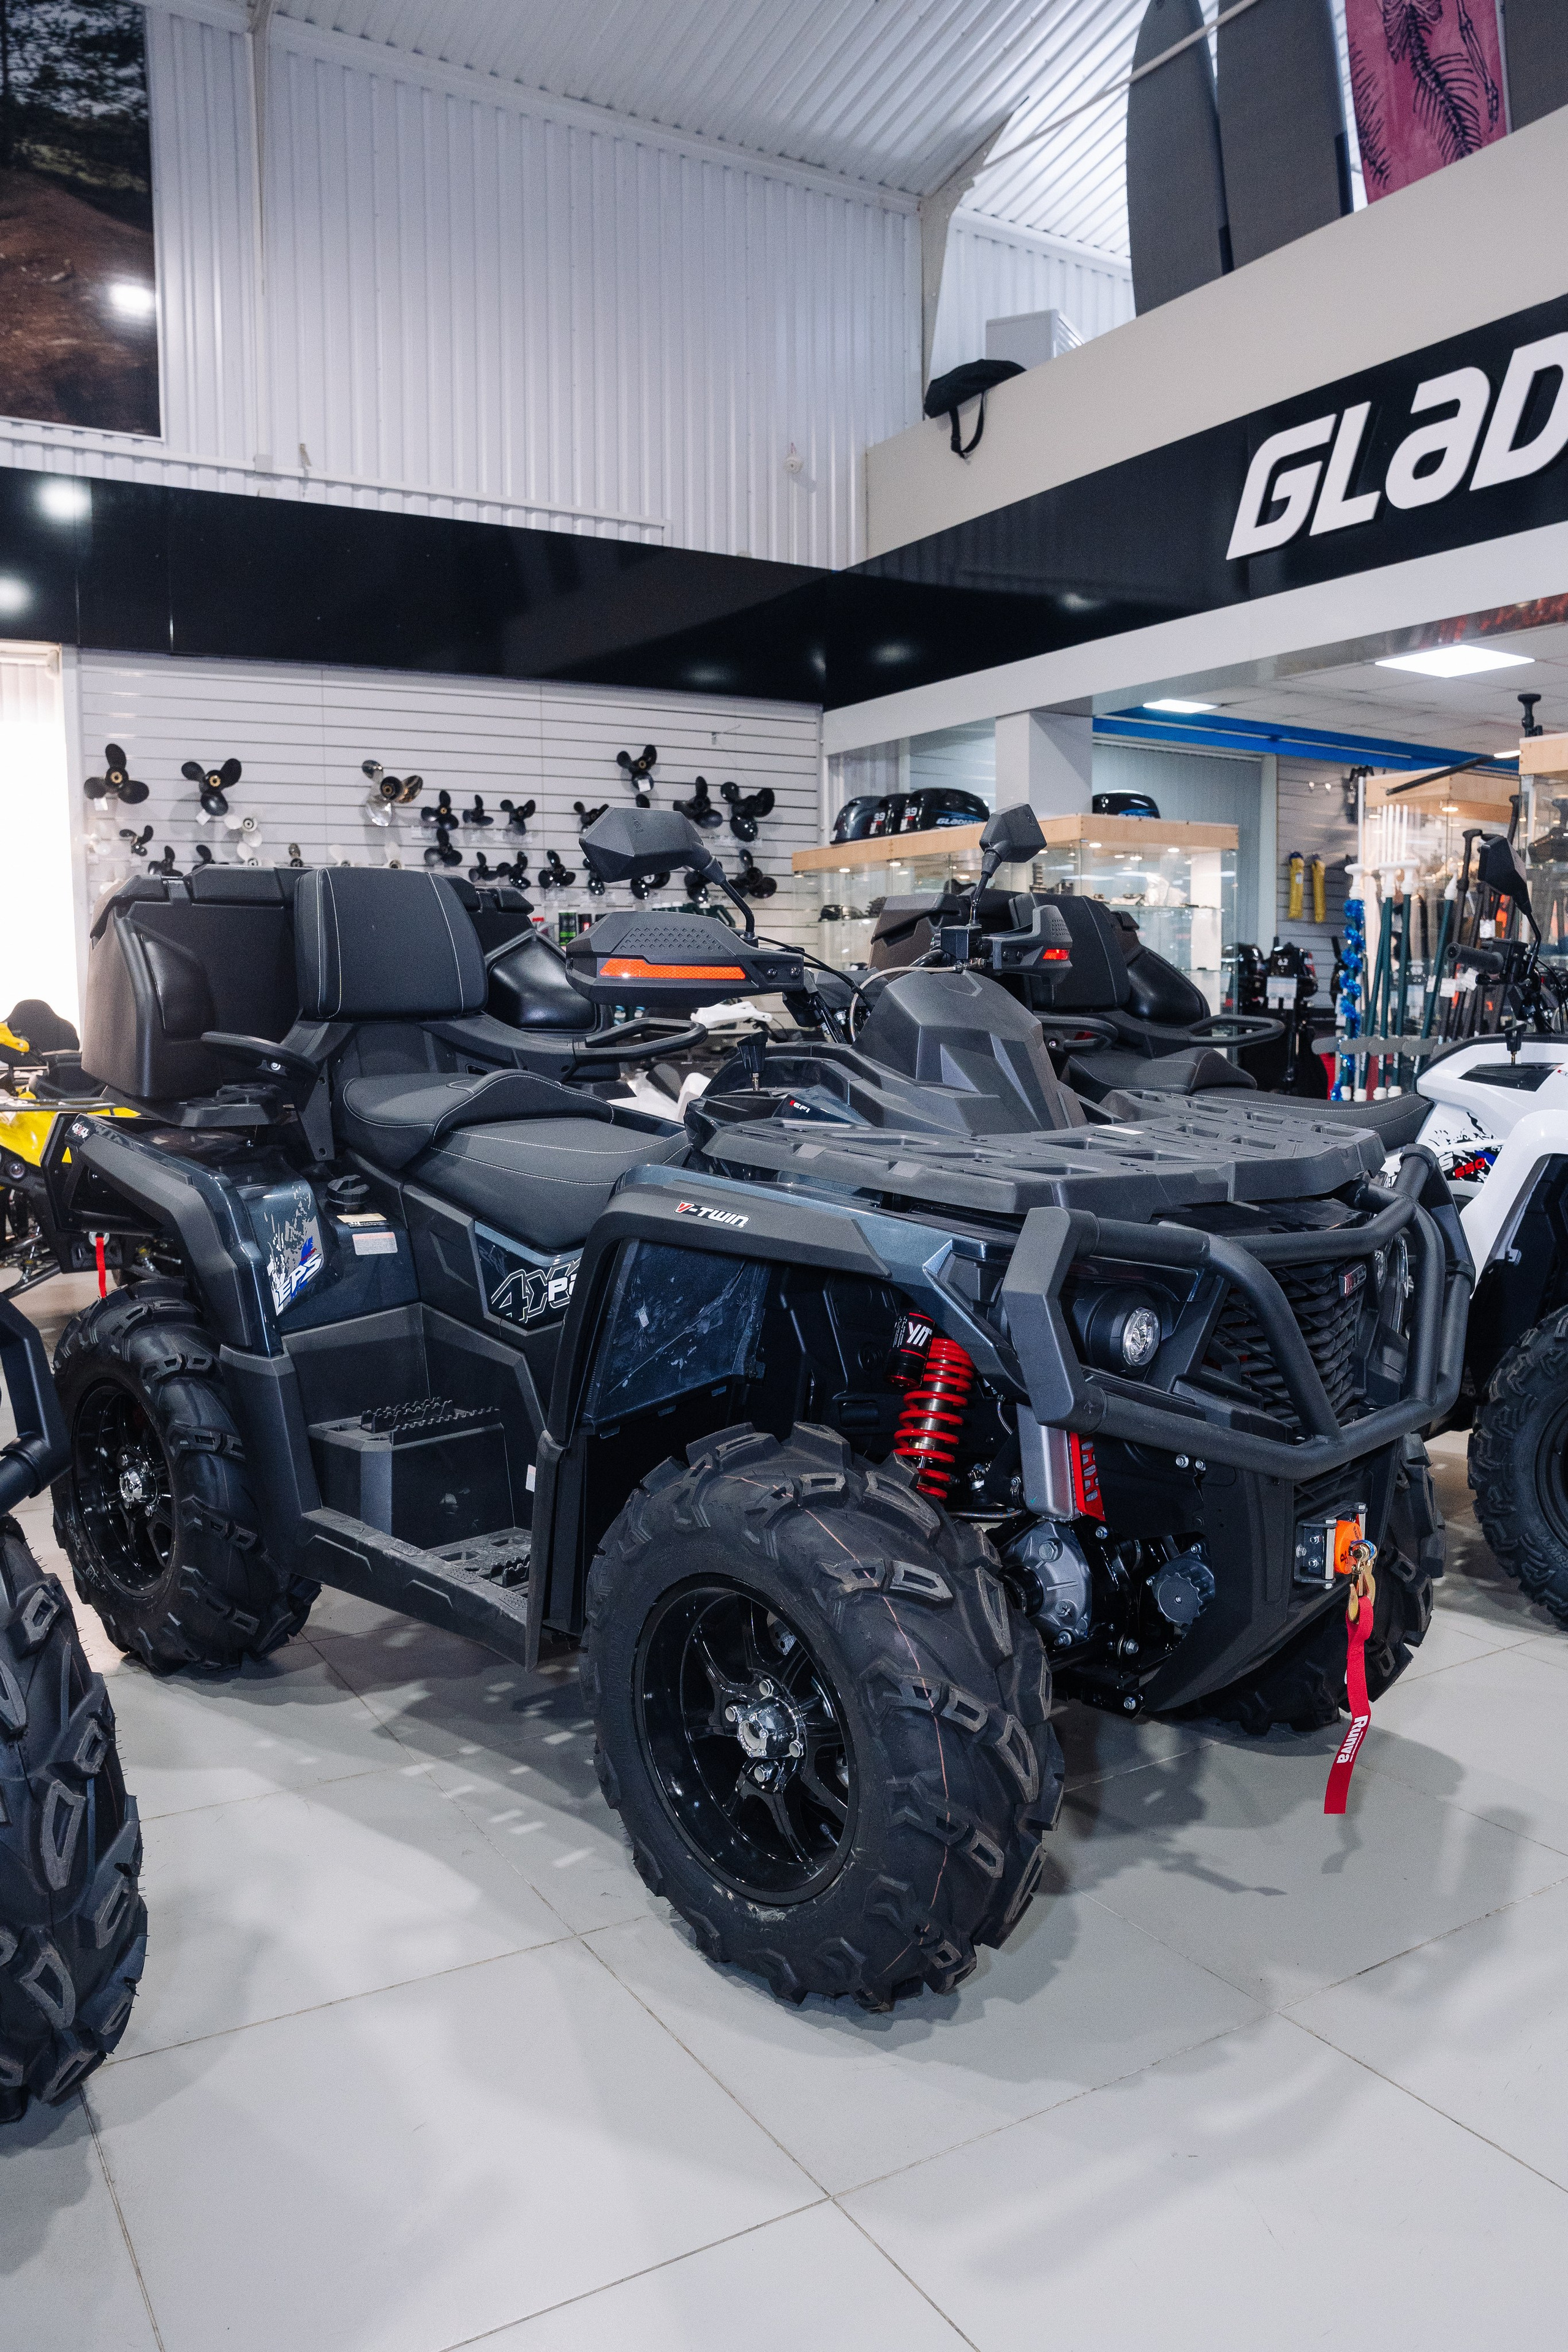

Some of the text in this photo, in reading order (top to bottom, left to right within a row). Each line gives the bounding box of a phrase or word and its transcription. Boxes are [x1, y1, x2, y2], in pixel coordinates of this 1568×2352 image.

[1455, 1157, 1485, 1178] 650
[276, 1253, 323, 1306] EPS
[1336, 1715, 1368, 1763] Runva
